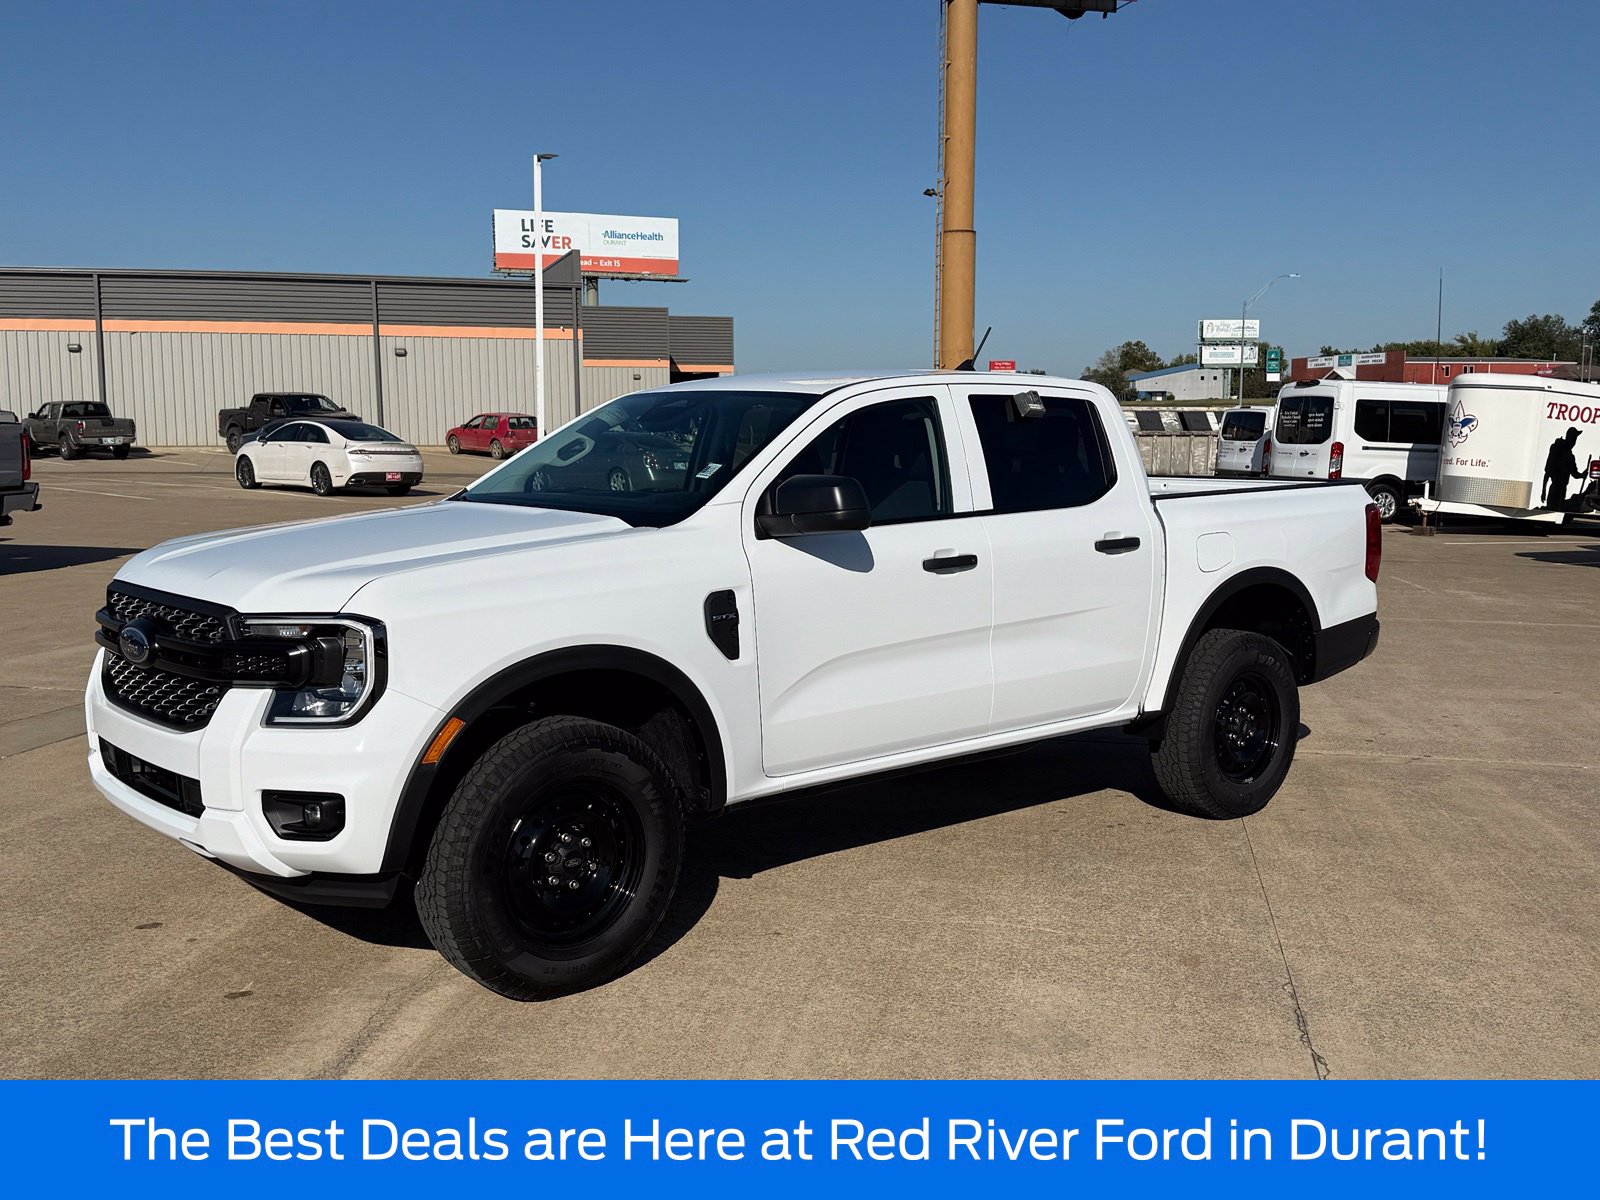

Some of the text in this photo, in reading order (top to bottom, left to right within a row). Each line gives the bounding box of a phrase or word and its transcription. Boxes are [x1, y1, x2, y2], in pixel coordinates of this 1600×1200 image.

[603, 230, 664, 242] AllianceHealth
[599, 259, 613, 267] Exit
[614, 259, 621, 267] 15
[1547, 401, 1600, 424] TROOP
[1456, 457, 1468, 466] For
